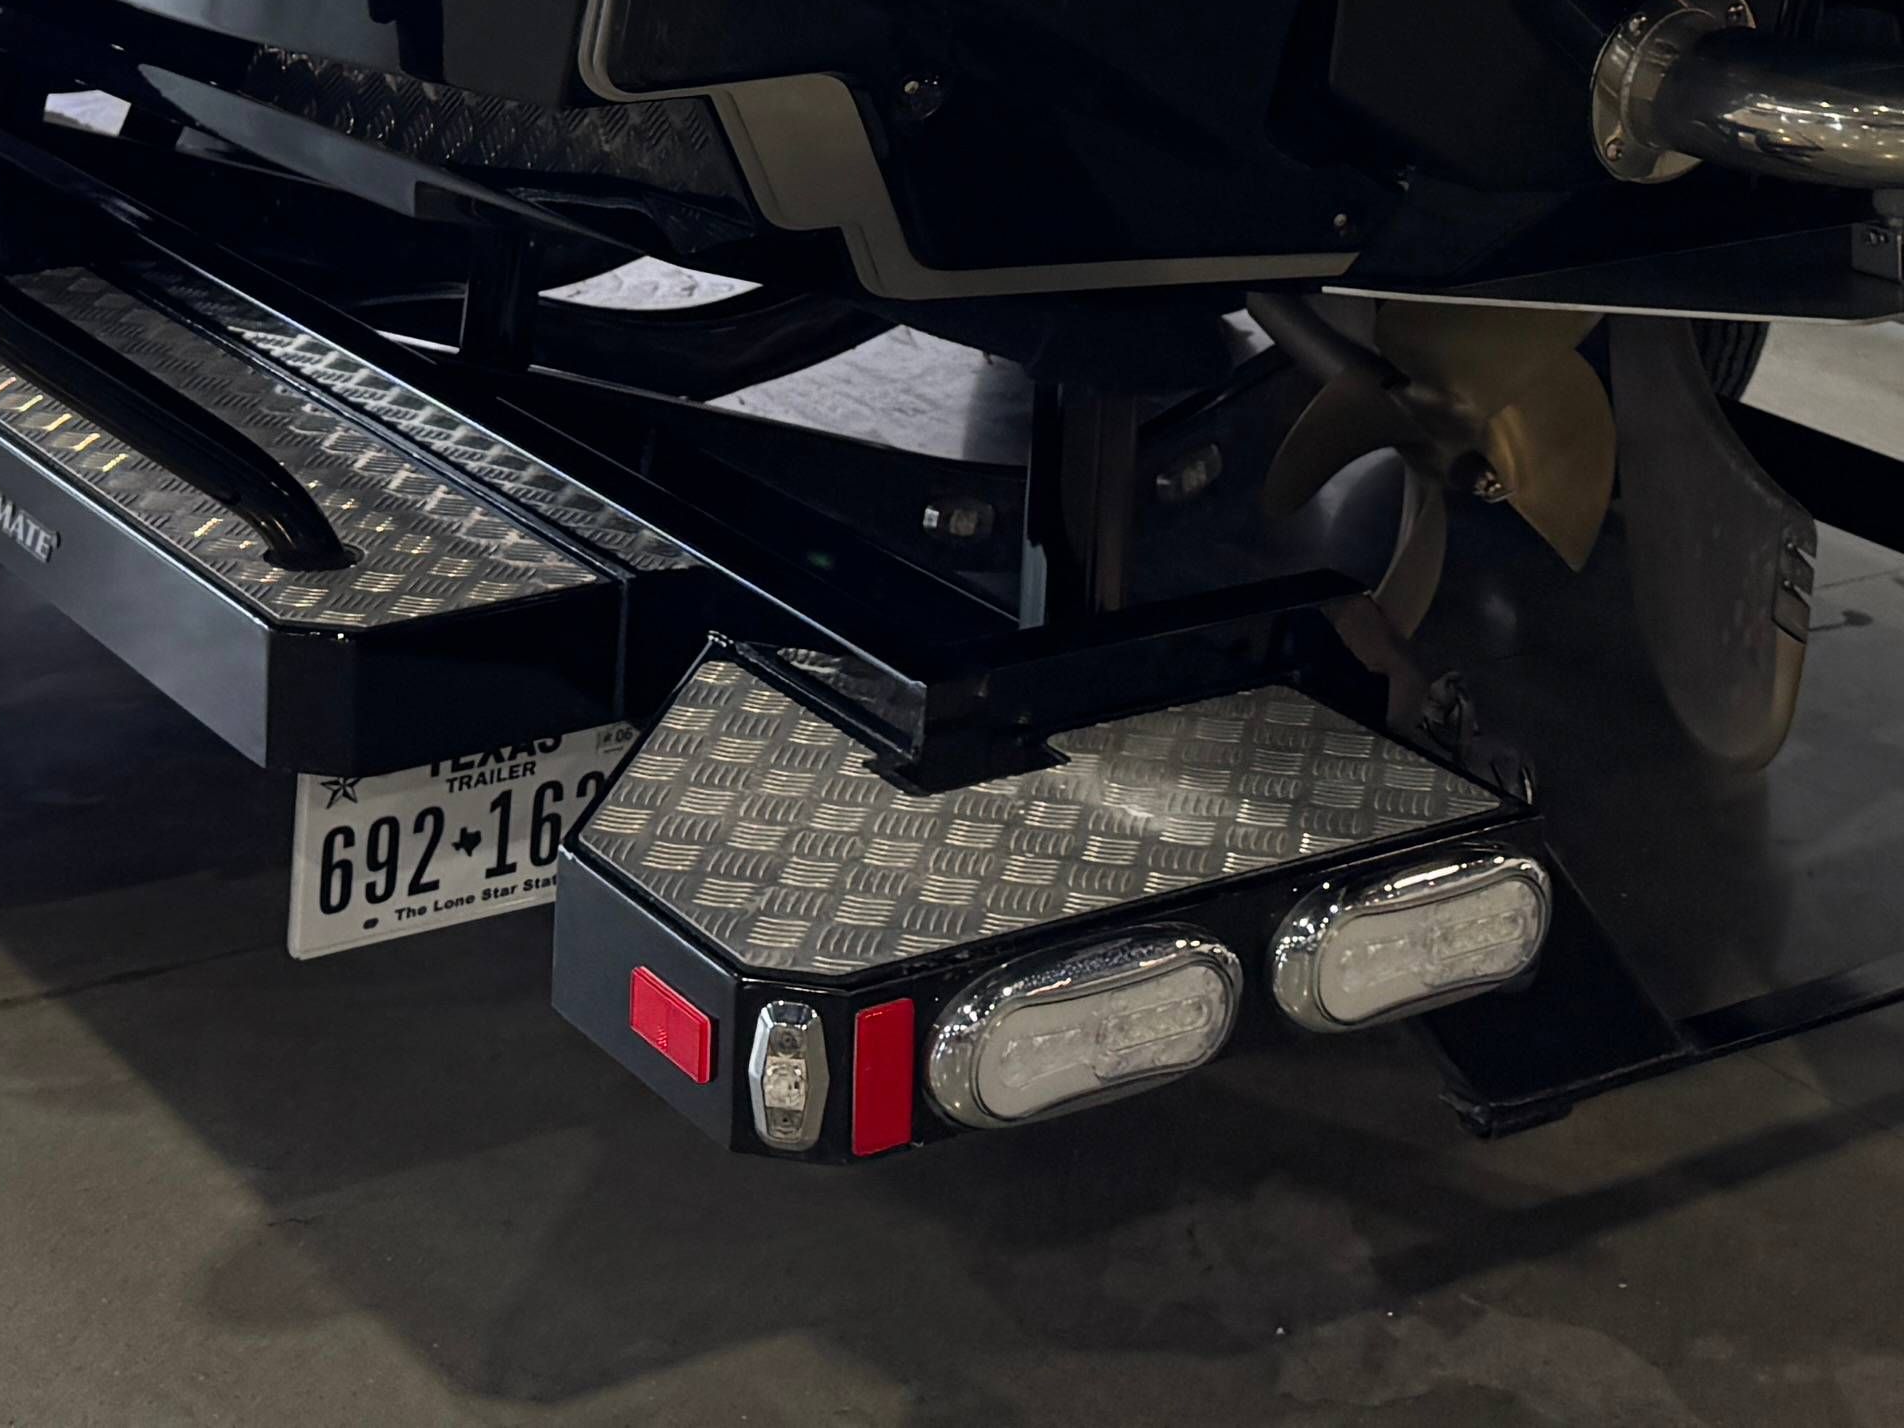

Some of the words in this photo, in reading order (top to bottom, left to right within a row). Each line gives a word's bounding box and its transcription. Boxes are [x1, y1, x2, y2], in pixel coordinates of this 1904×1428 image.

[445, 760, 537, 794] TRAILER
[319, 805, 446, 915] 692
[394, 905, 428, 921] The
[433, 893, 476, 913] Lone
[480, 884, 518, 901] Star
[522, 873, 558, 892] Stat
